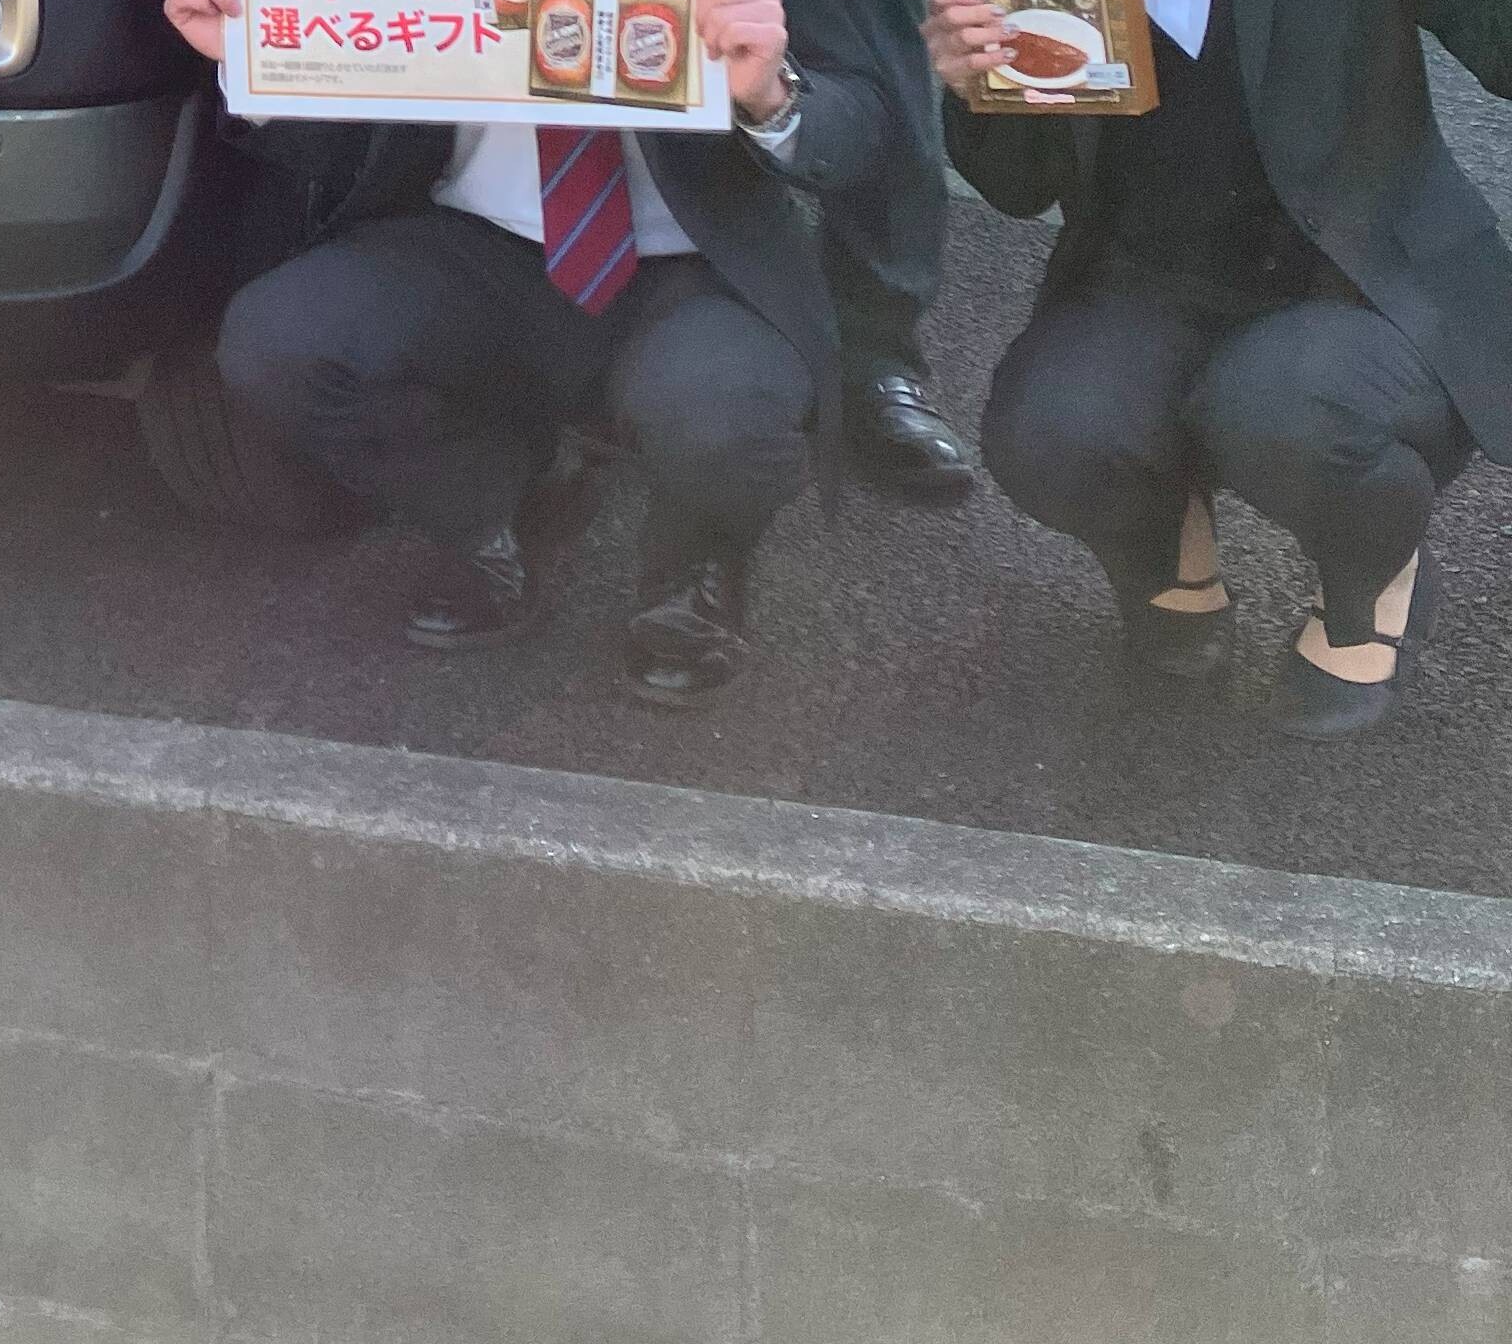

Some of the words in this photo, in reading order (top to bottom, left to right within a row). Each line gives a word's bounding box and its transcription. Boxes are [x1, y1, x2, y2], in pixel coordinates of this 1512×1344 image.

[259, 6, 503, 54] 選べるギフト
